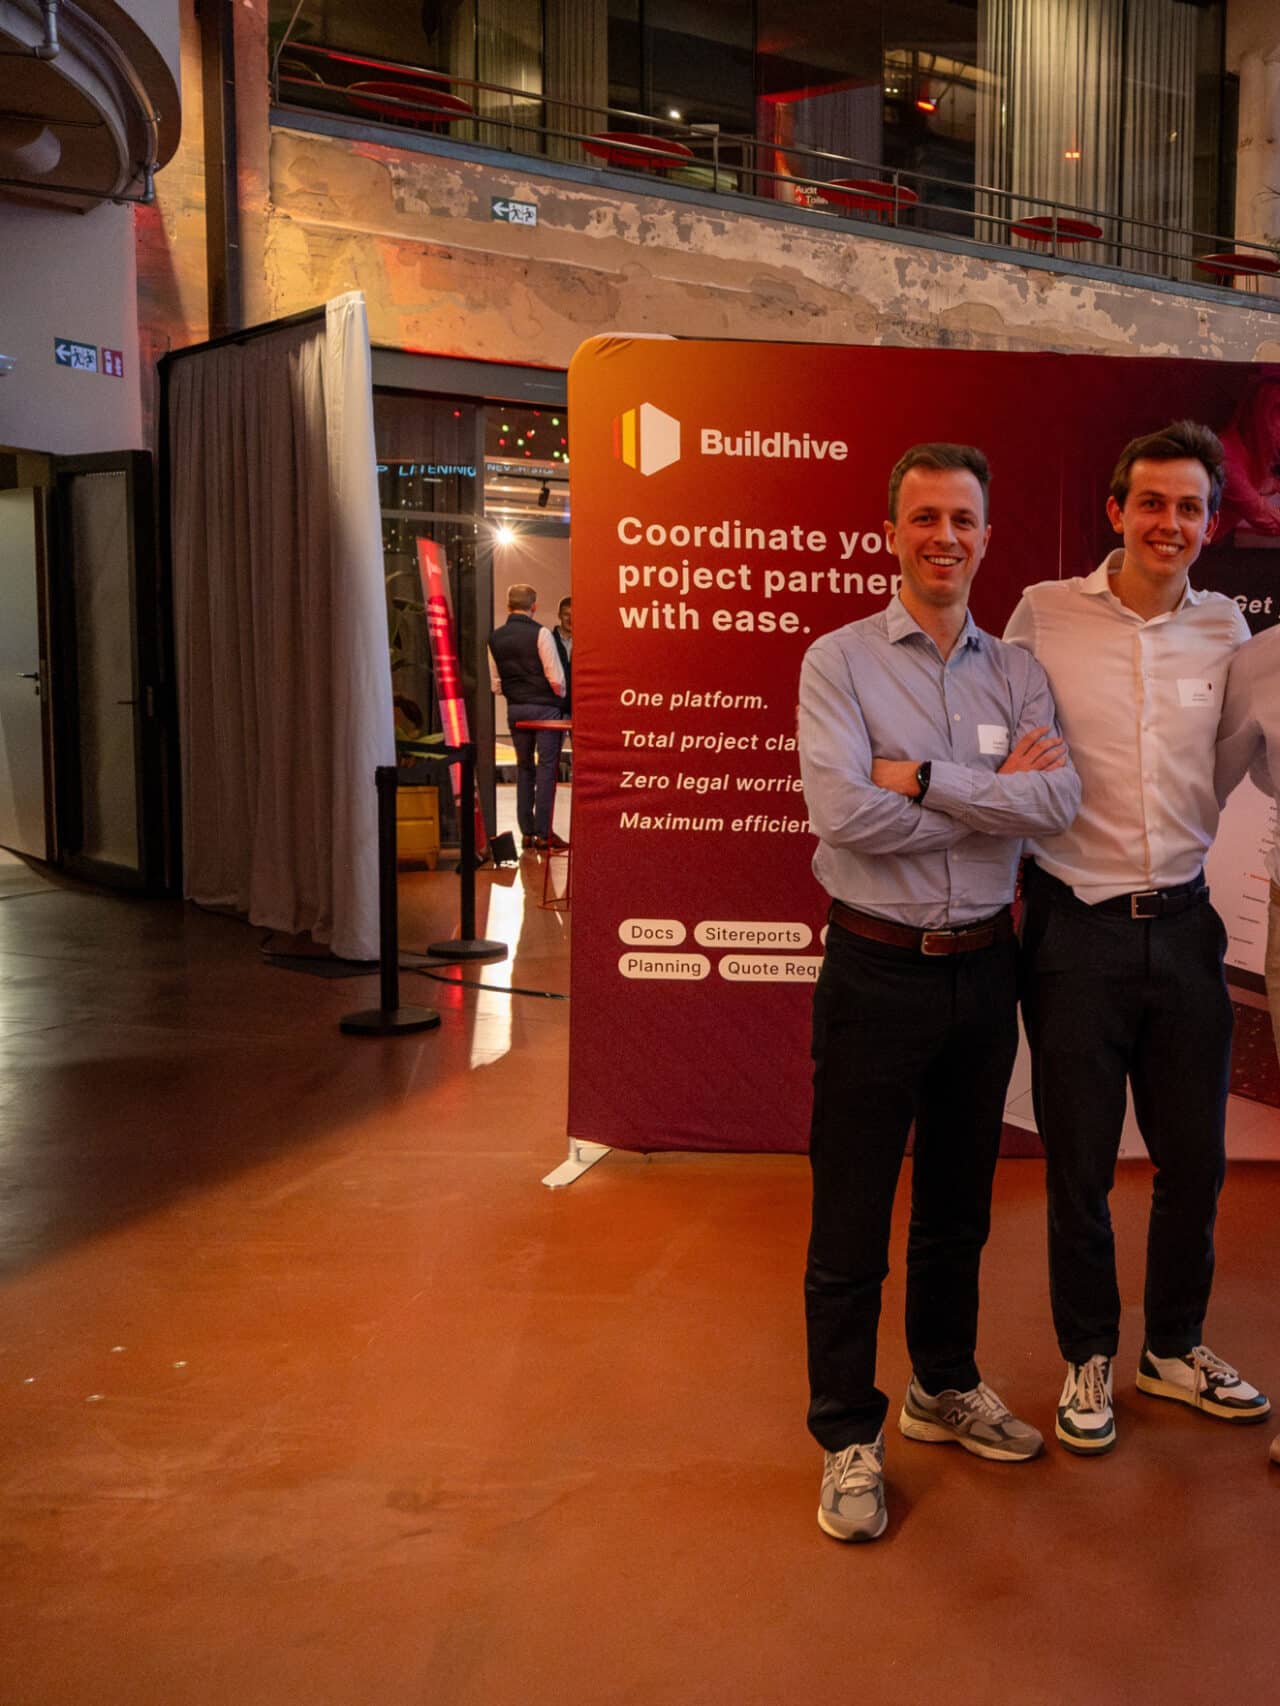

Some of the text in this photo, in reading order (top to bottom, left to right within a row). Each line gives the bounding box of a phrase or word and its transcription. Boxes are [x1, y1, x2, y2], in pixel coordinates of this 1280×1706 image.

[700, 428, 849, 461] Buildhive
[617, 516, 827, 552] Coordinate
[618, 559, 752, 595] project
[1233, 595, 1272, 614] Get
[619, 599, 811, 634] with ease.
[620, 689, 769, 711] One platform.
[621, 730, 676, 749] Total
[680, 732, 760, 753] project
[619, 771, 804, 795] Zero legal worrie
[619, 812, 724, 832] Maximum
[631, 926, 674, 940] Docs
[705, 927, 801, 944] Sitereports
[627, 959, 702, 977] Planning
[728, 961, 779, 976] Quote
